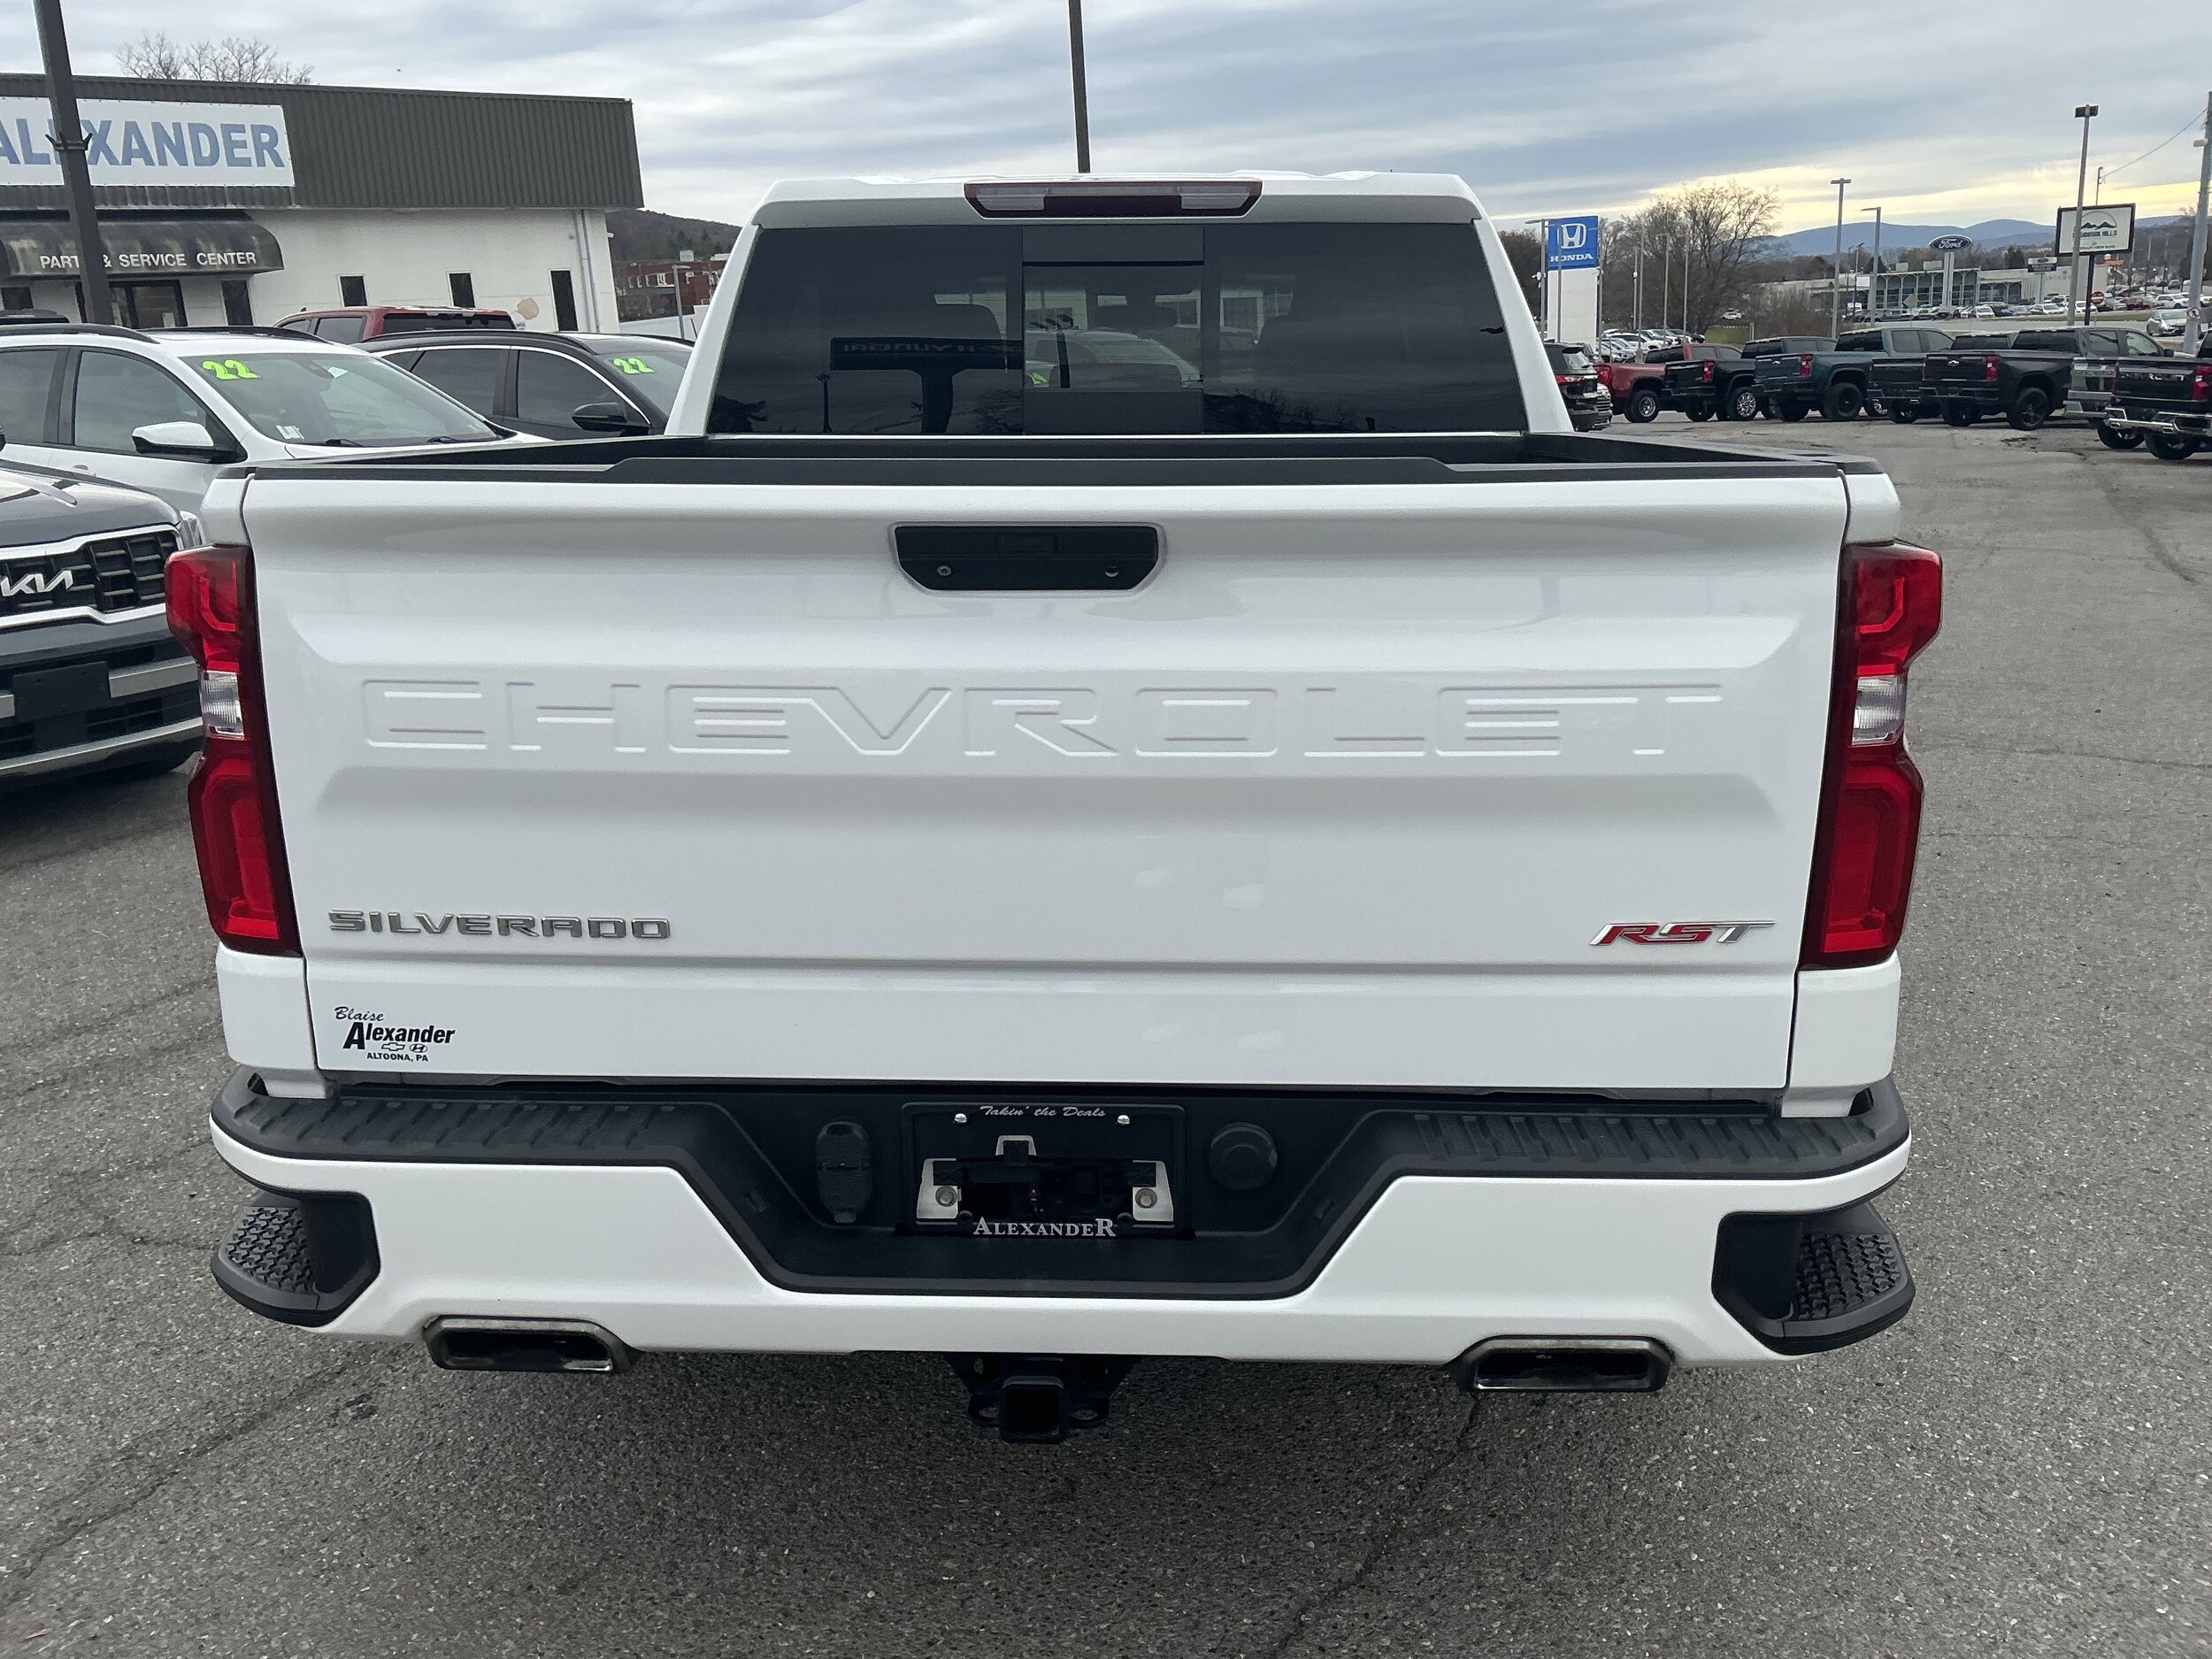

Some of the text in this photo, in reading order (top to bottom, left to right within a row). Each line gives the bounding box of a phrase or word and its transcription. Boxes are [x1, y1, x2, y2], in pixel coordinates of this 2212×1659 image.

[0, 117, 285, 167] ALXANDER
[1938, 238, 1963, 250] Ford
[40, 255, 80, 269] PART
[119, 253, 187, 268] SERVICE
[196, 252, 257, 266] CENTER
[1549, 253, 1594, 263] HONDA
[203, 359, 261, 380] 22
[613, 357, 656, 374] 22
[0, 569, 73, 597] KIA
[362, 679, 1723, 757] CHEVROLET
[328, 909, 671, 940] SILVERADO
[1590, 920, 1777, 946] RST
[334, 1006, 384, 1022] Blaise
[342, 1021, 456, 1050] Alexander
[366, 1052, 413, 1063] ALTOONA,
[979, 1105, 1106, 1117] Takin' the Deals
